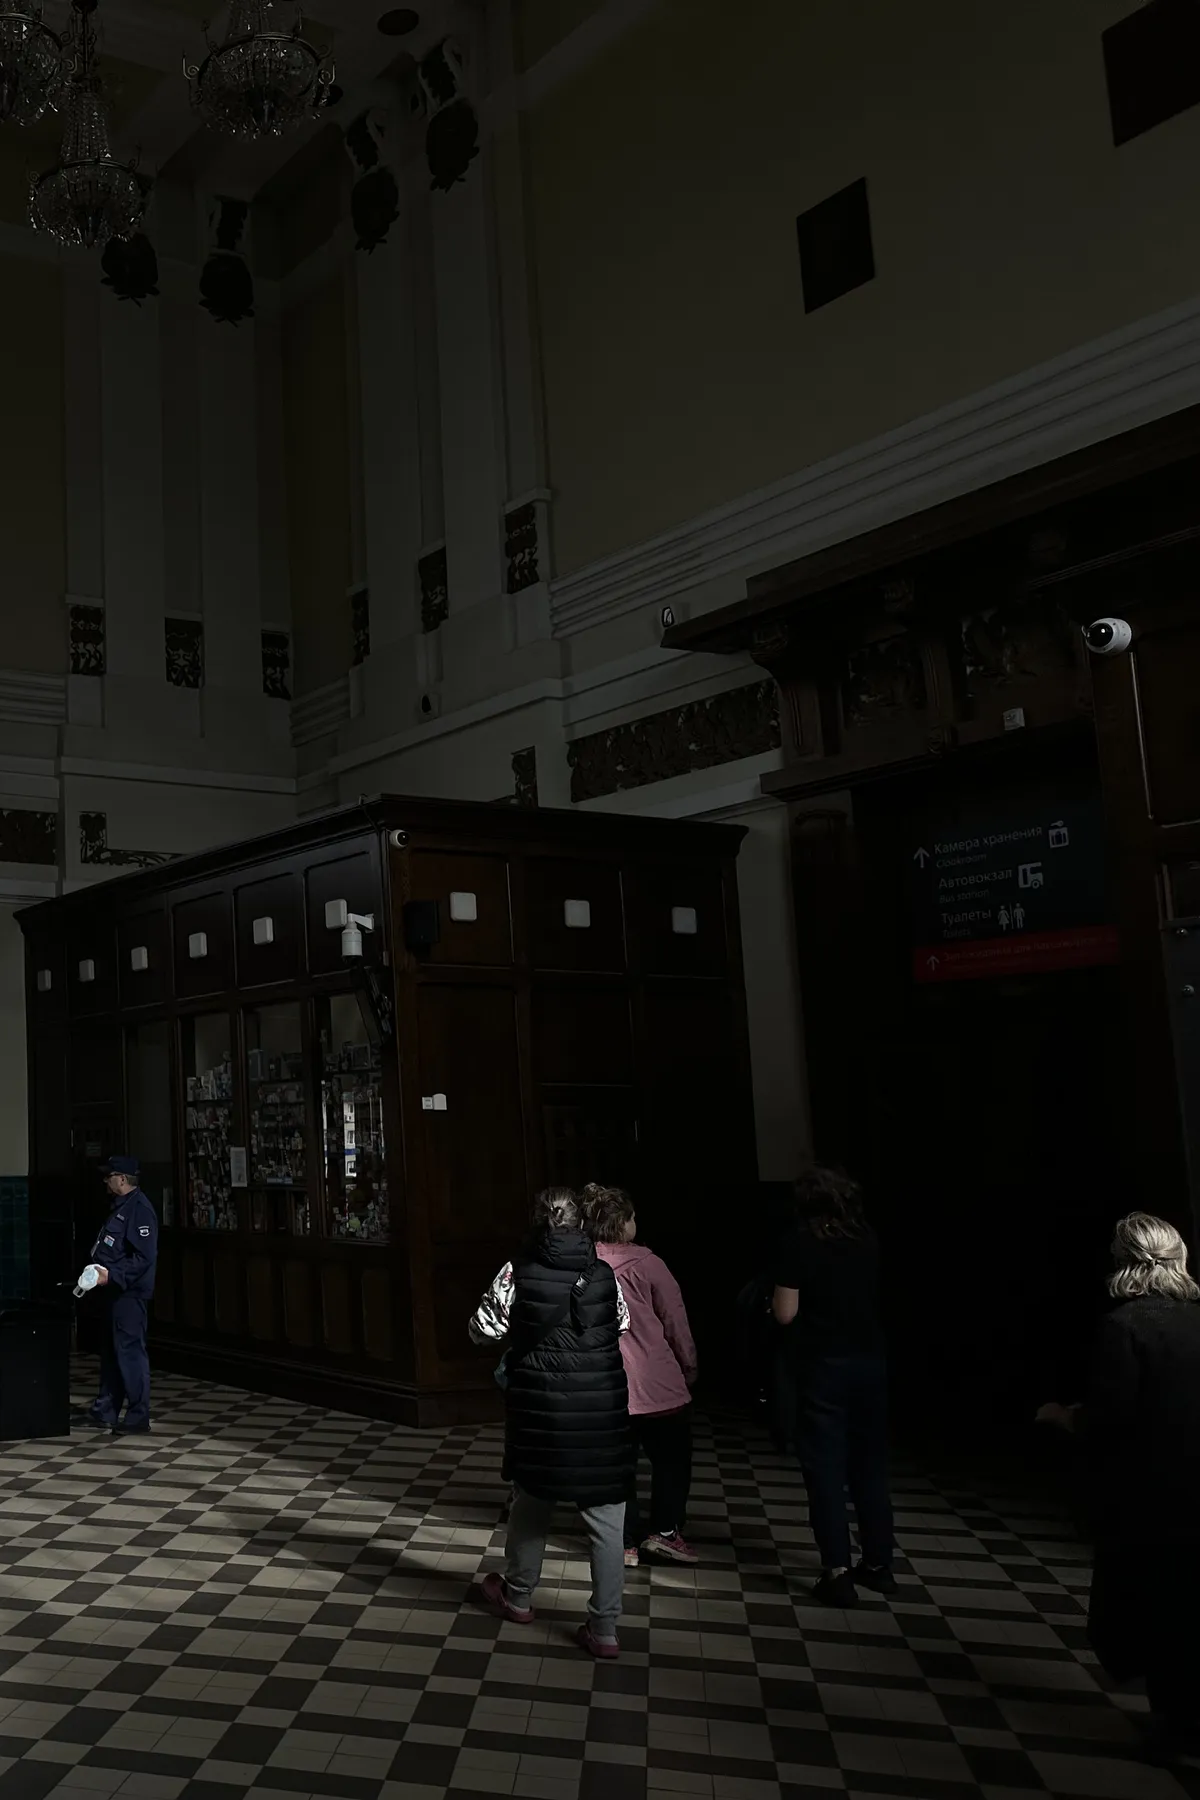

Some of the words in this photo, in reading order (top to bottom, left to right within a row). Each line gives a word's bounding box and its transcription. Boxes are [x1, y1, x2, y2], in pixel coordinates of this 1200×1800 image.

[934, 838, 980, 854] Камера
[982, 826, 1043, 847] хранения
[938, 869, 1013, 889] Автовокзал
[939, 909, 992, 927] Туалеты
